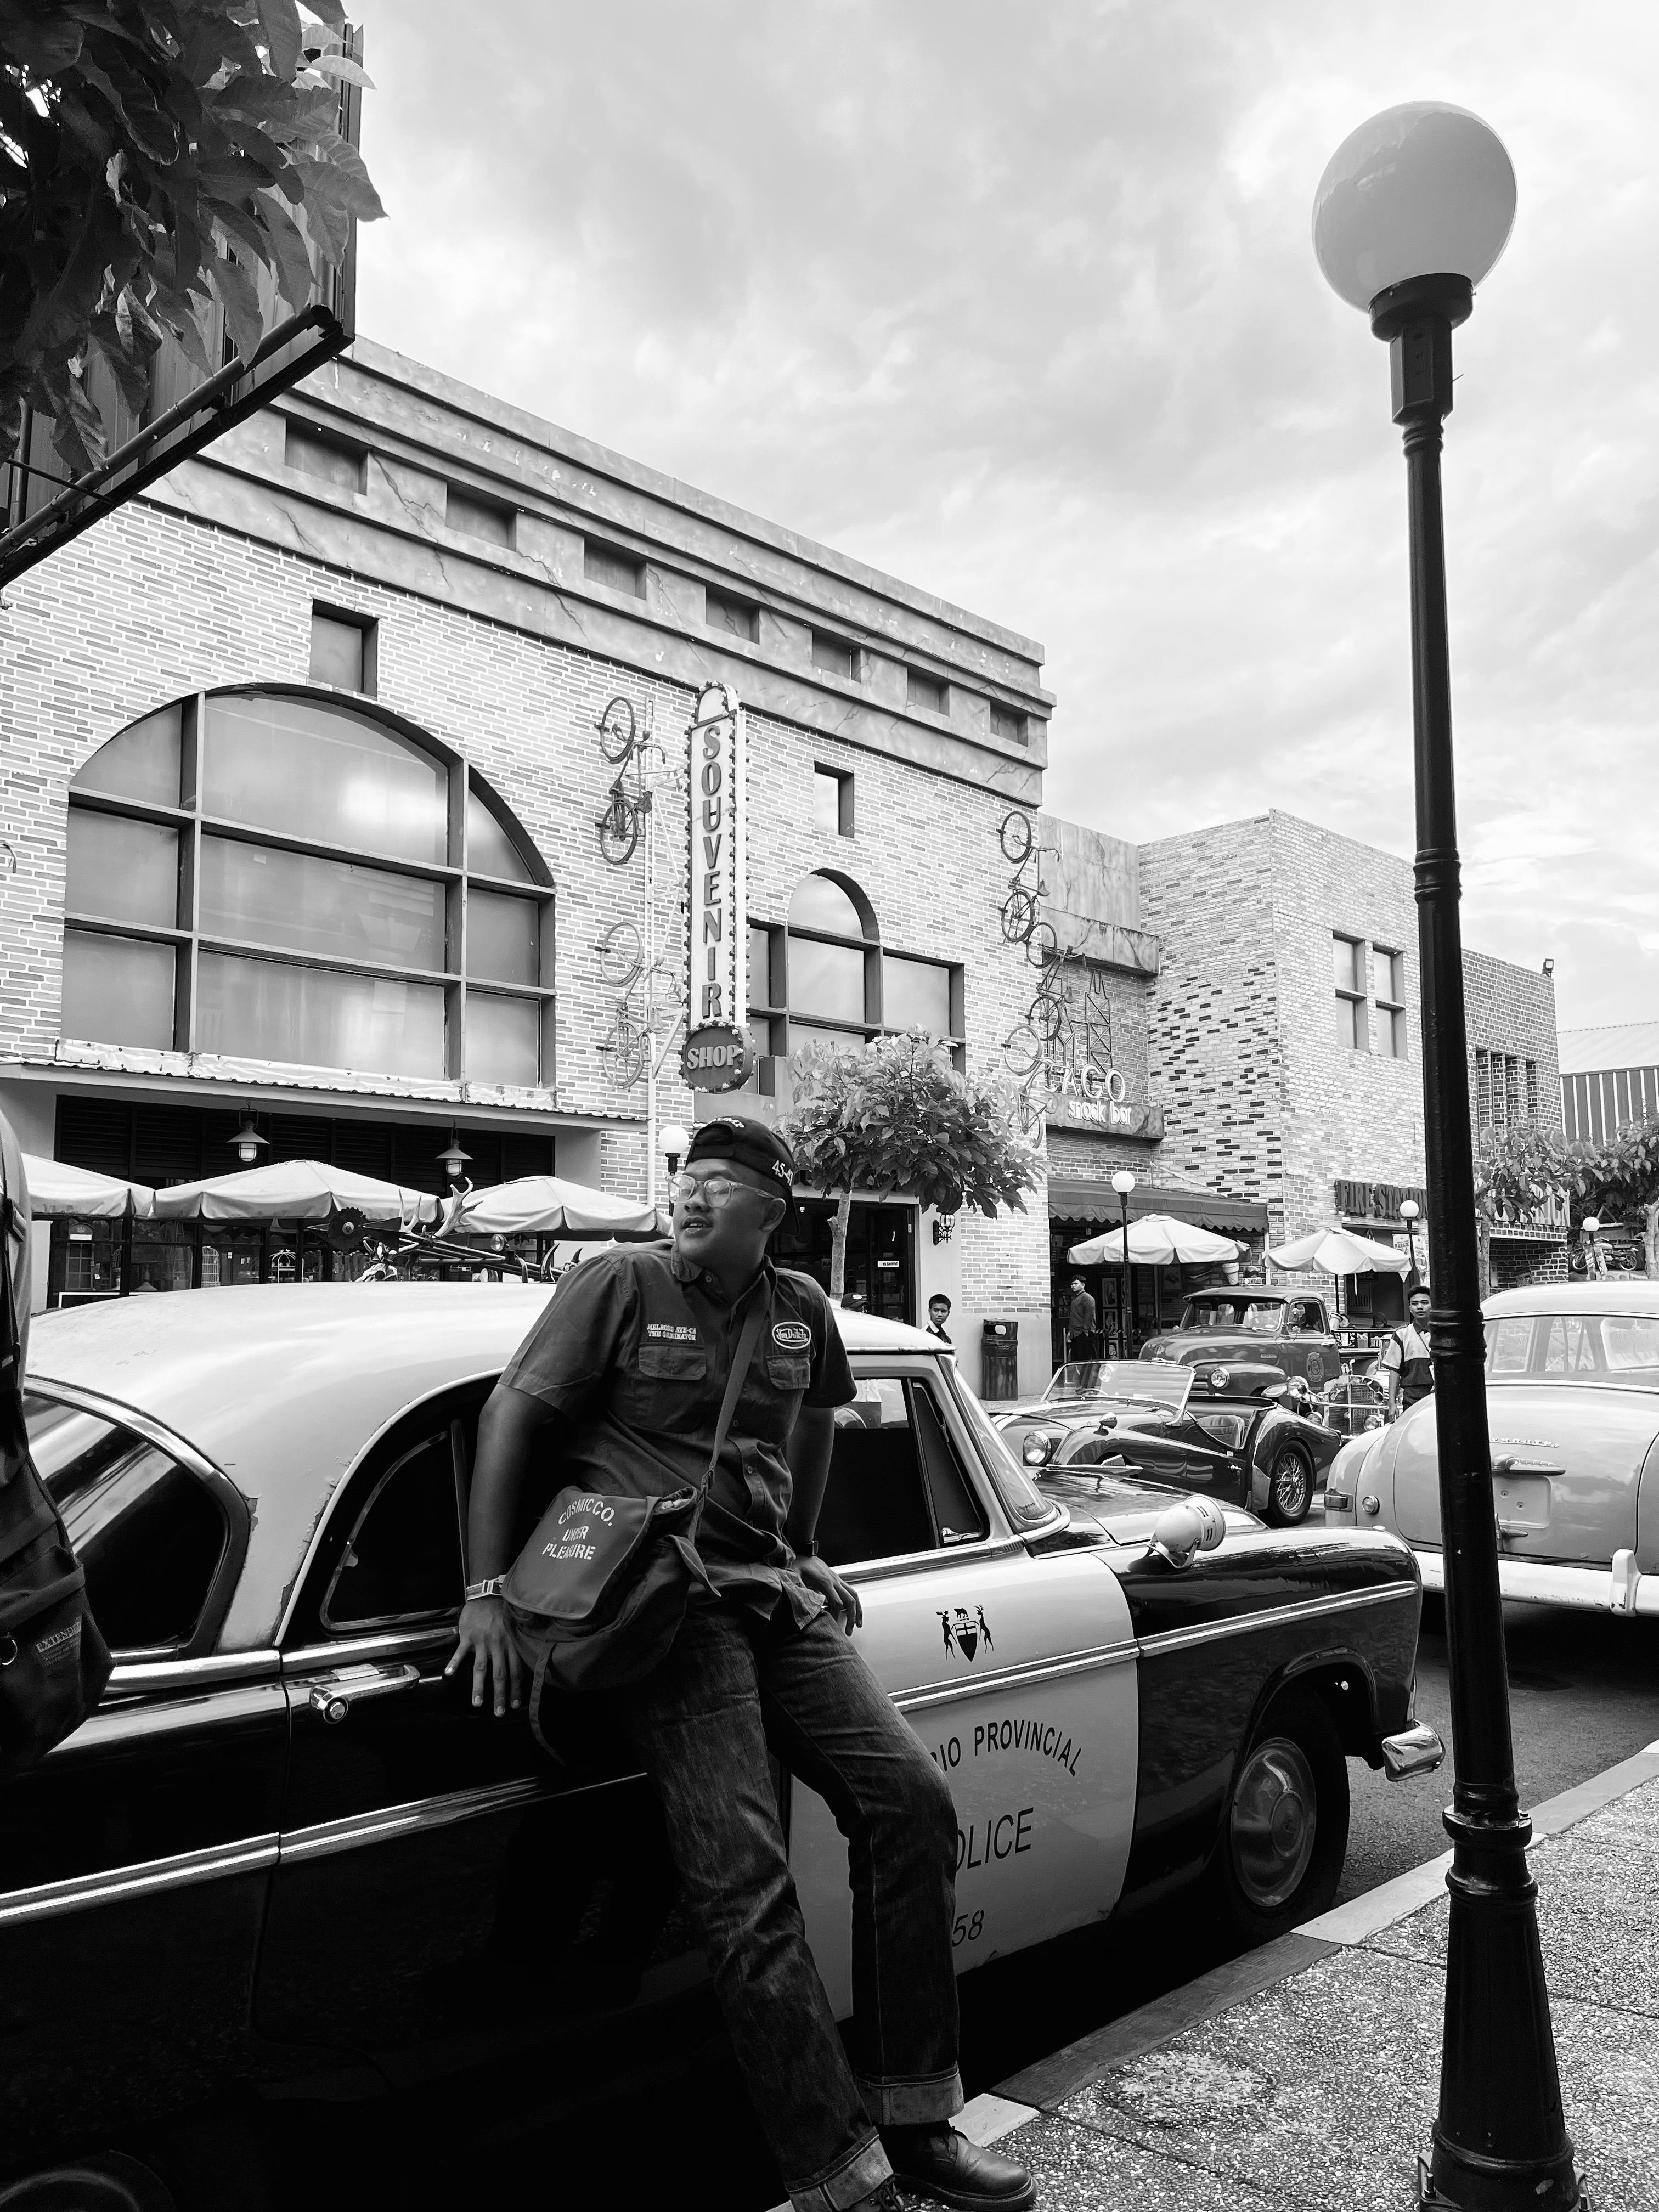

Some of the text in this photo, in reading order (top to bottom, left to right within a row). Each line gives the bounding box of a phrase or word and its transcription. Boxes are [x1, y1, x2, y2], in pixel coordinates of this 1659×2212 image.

[701, 725, 723, 1019] SOUVENIR
[687, 1044, 740, 1069] SHOP
[1045, 1061, 1125, 1102] AGO
[1068, 1100, 1132, 1125] snack bar
[1337, 1180, 1373, 1215] FIRE
[662, 1331, 696, 1341] ORIGINATOR
[558, 1498, 614, 1527] COSMIC CO.
[562, 1526, 589, 1542] UNDER
[974, 1719, 1082, 1778] PROVINCIAL
[952, 1909, 985, 1948] 58
